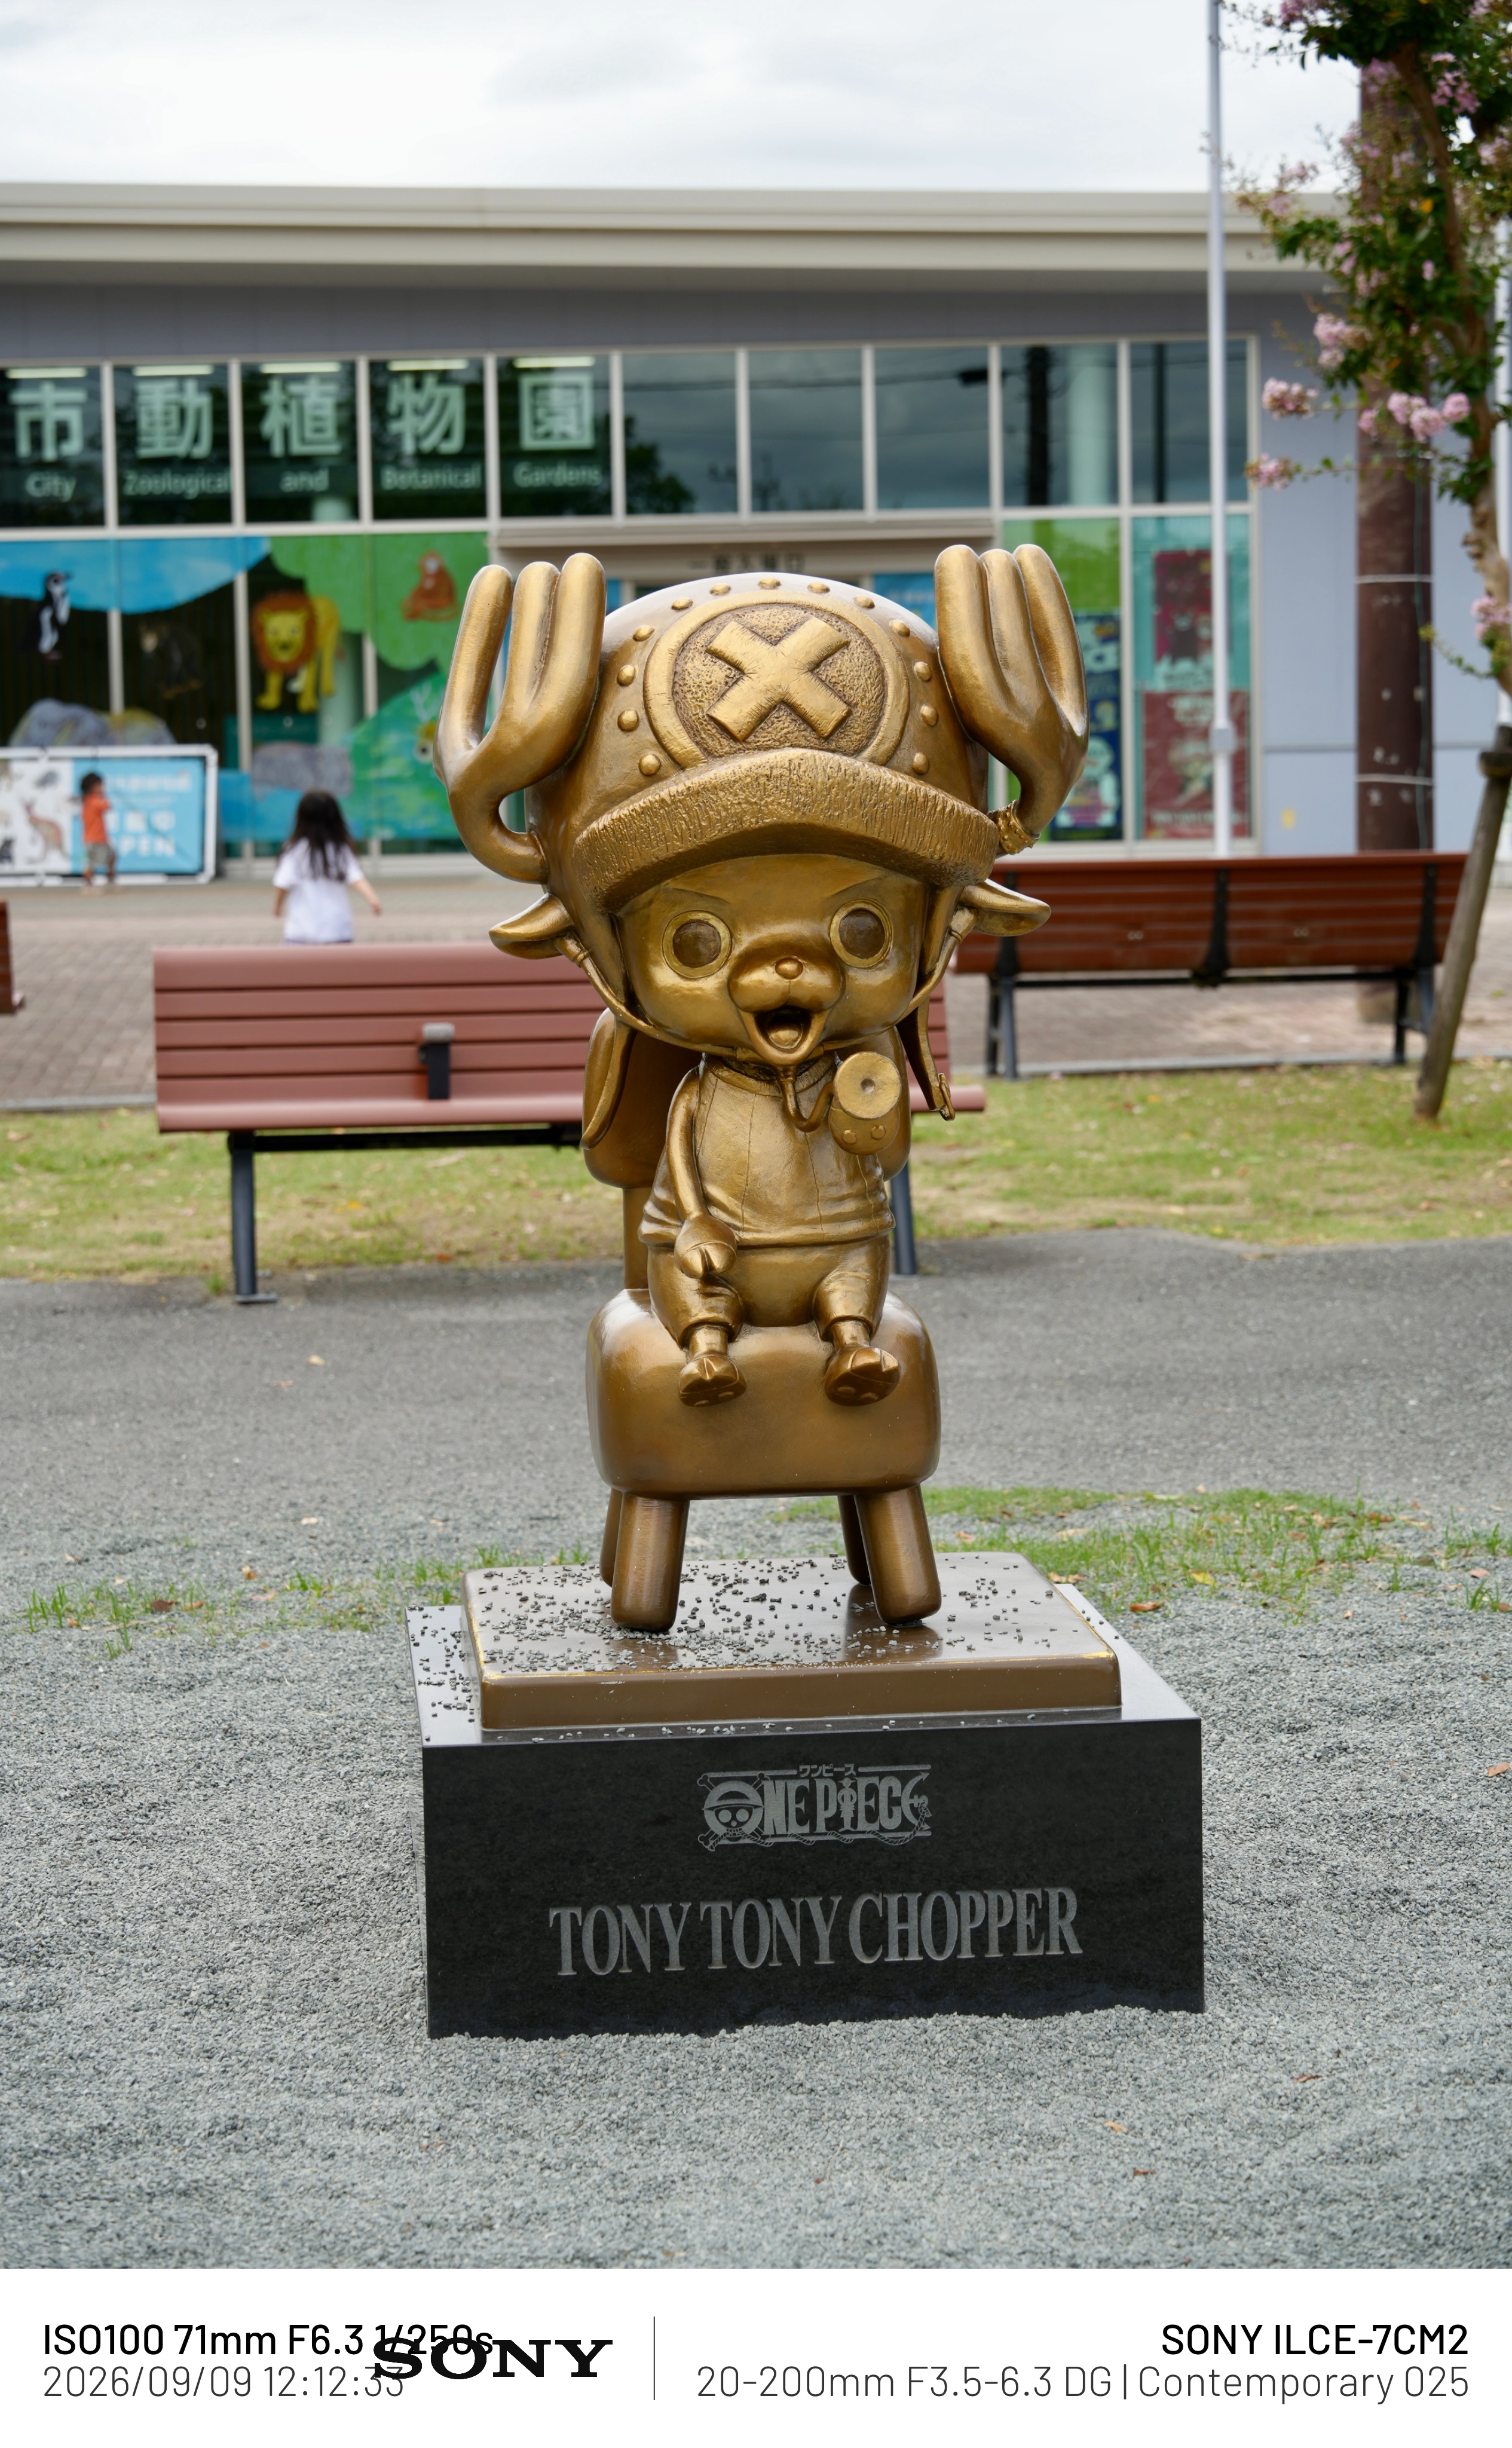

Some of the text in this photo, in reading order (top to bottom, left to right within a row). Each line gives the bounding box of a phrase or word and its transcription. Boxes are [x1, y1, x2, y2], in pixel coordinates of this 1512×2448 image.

[9, 373, 595, 461] 市動植物園
[25, 461, 602, 503] City Zoological and Botanical Gardens
[110, 835, 176, 857] PEN
[798, 1763, 856, 1778] ワンピース
[813, 1772, 932, 1833] PIECE
[549, 1886, 1082, 1976] TONY TONY CHOPPER
